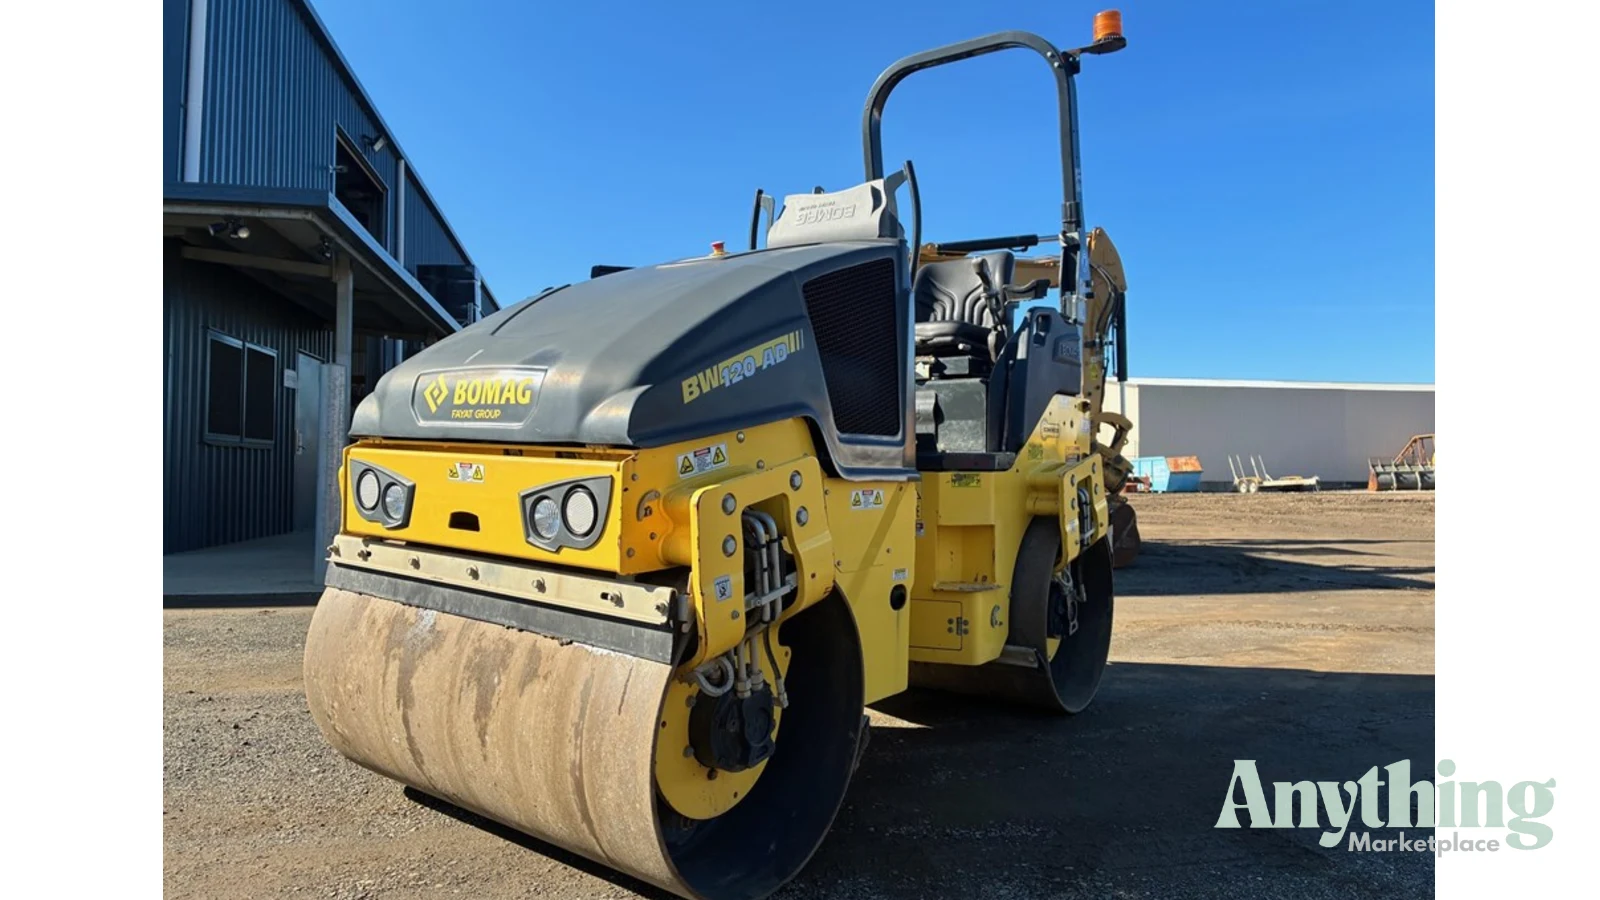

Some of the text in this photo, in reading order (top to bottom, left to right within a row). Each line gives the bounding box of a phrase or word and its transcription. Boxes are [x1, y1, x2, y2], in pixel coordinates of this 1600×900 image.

[761, 342, 788, 371] AD
[452, 376, 534, 406] BOMAG
[451, 408, 502, 420] FAYAT GROUP
